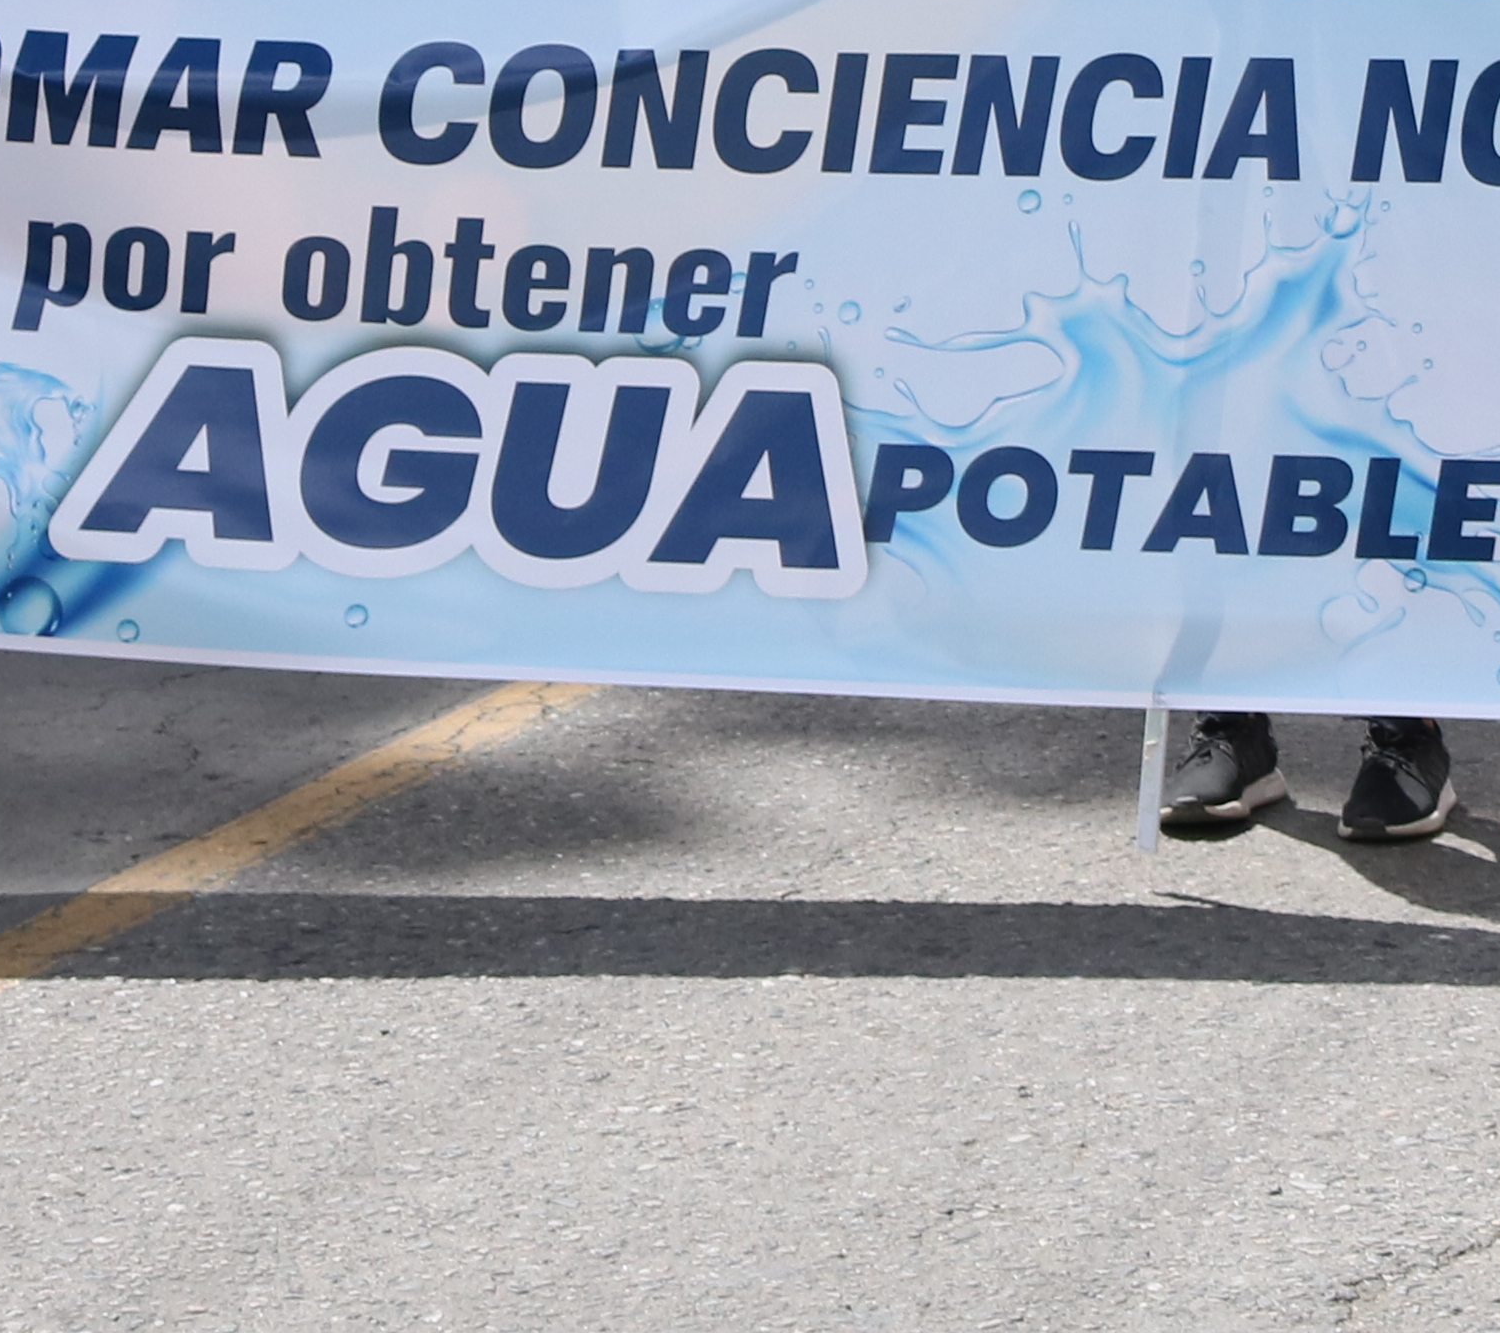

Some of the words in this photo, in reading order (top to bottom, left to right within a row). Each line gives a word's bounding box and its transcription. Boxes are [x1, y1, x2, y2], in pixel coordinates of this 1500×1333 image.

[377, 41, 1302, 181] CONCIENCIA
[12, 217, 237, 332] por
[282, 203, 800, 340] obtener
[77, 363, 841, 571] AGUA
